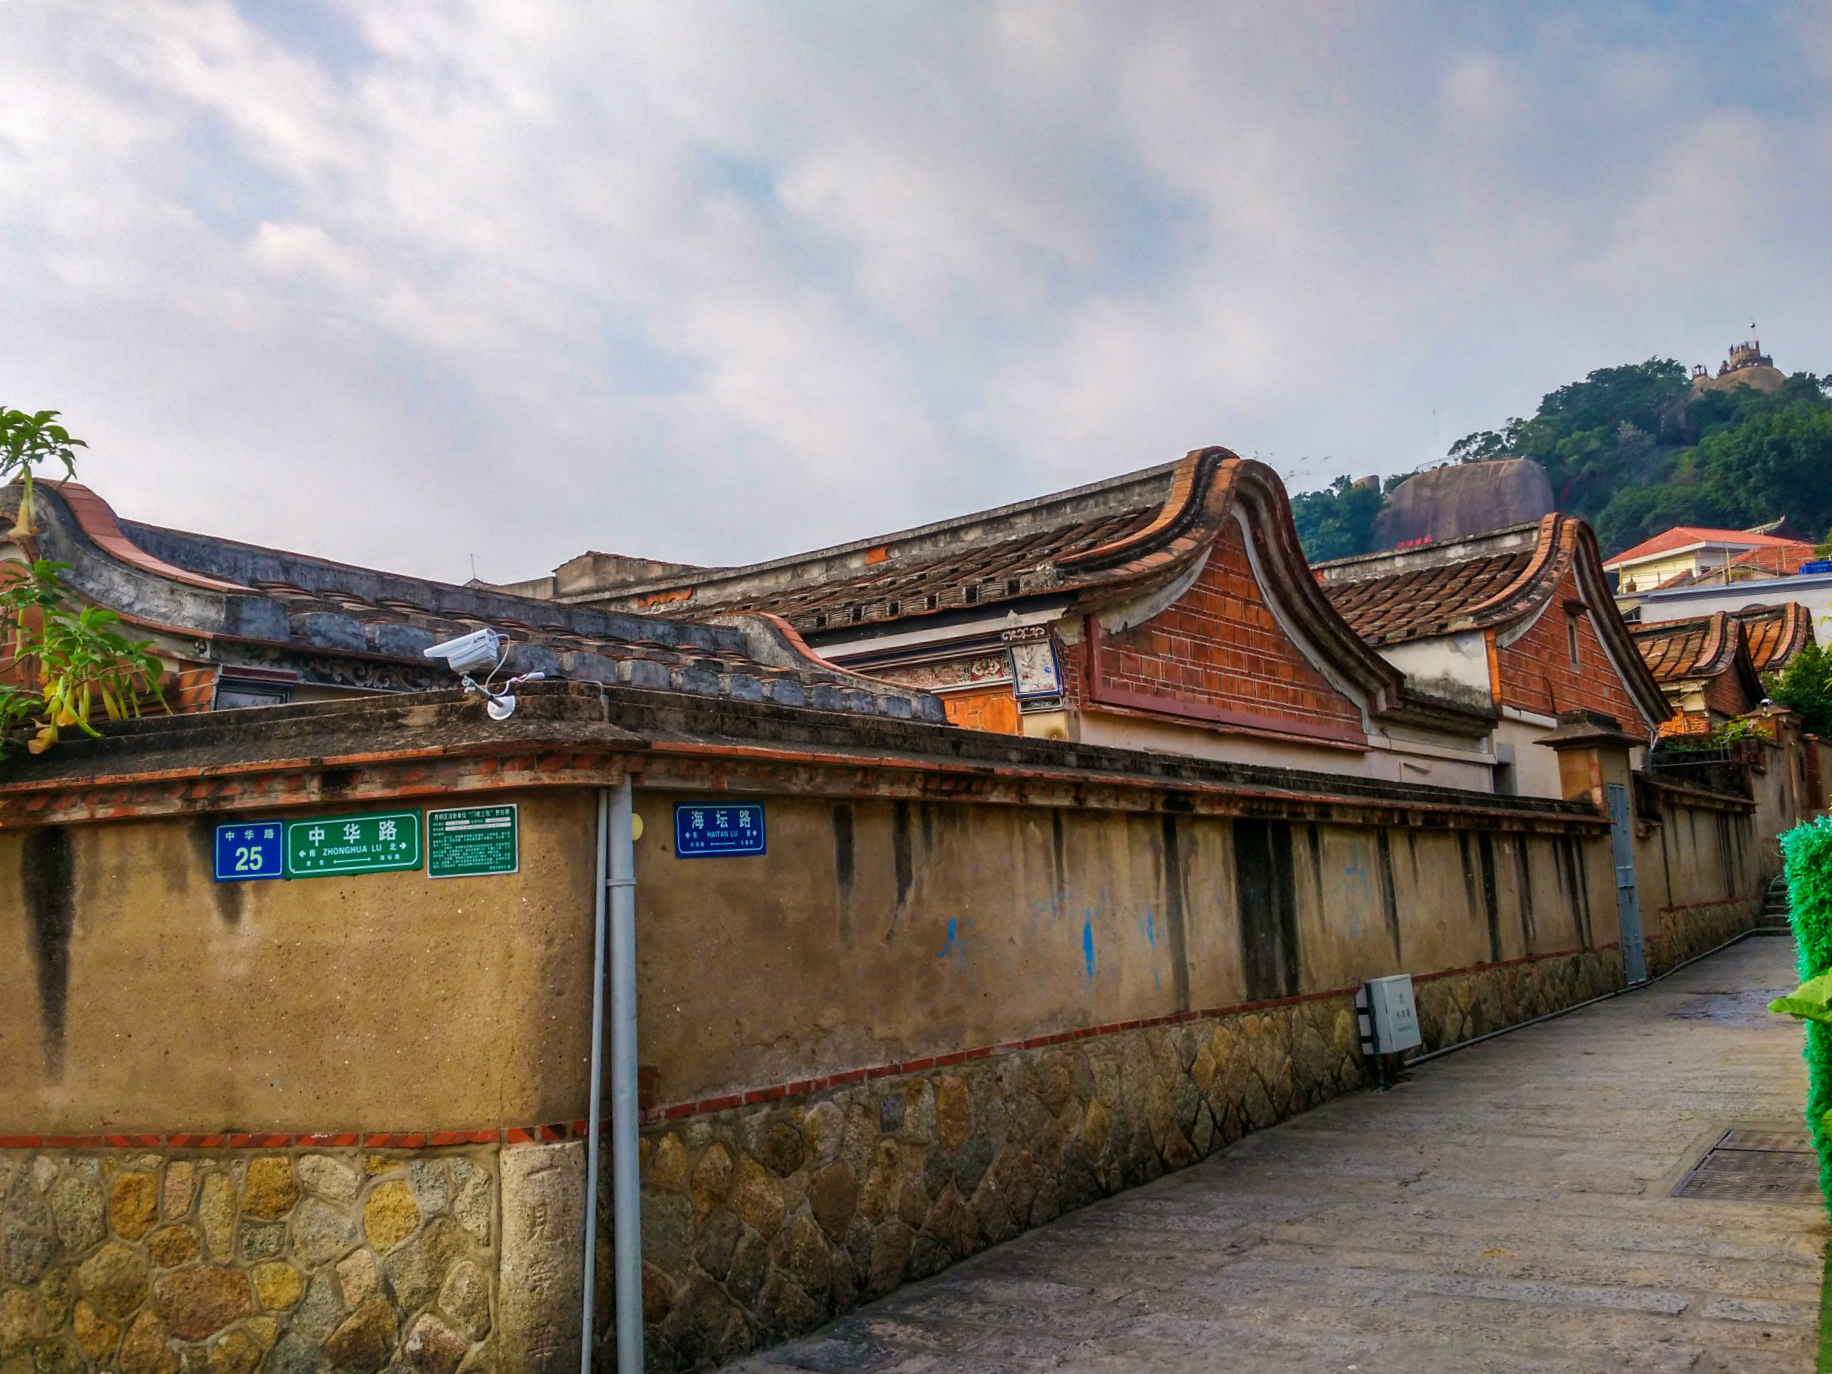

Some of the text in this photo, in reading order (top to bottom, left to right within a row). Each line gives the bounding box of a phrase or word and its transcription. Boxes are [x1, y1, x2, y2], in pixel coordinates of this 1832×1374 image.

[691, 810, 751, 829] 海坛路
[225, 828, 274, 841] 中华路
[308, 820, 397, 846] 中华路
[707, 830, 729, 838] HAITAN
[322, 844, 382, 857] ZHONGHUA LU
[389, 842, 397, 851] 北
[235, 846, 263, 871] 25
[308, 849, 316, 858] 南
